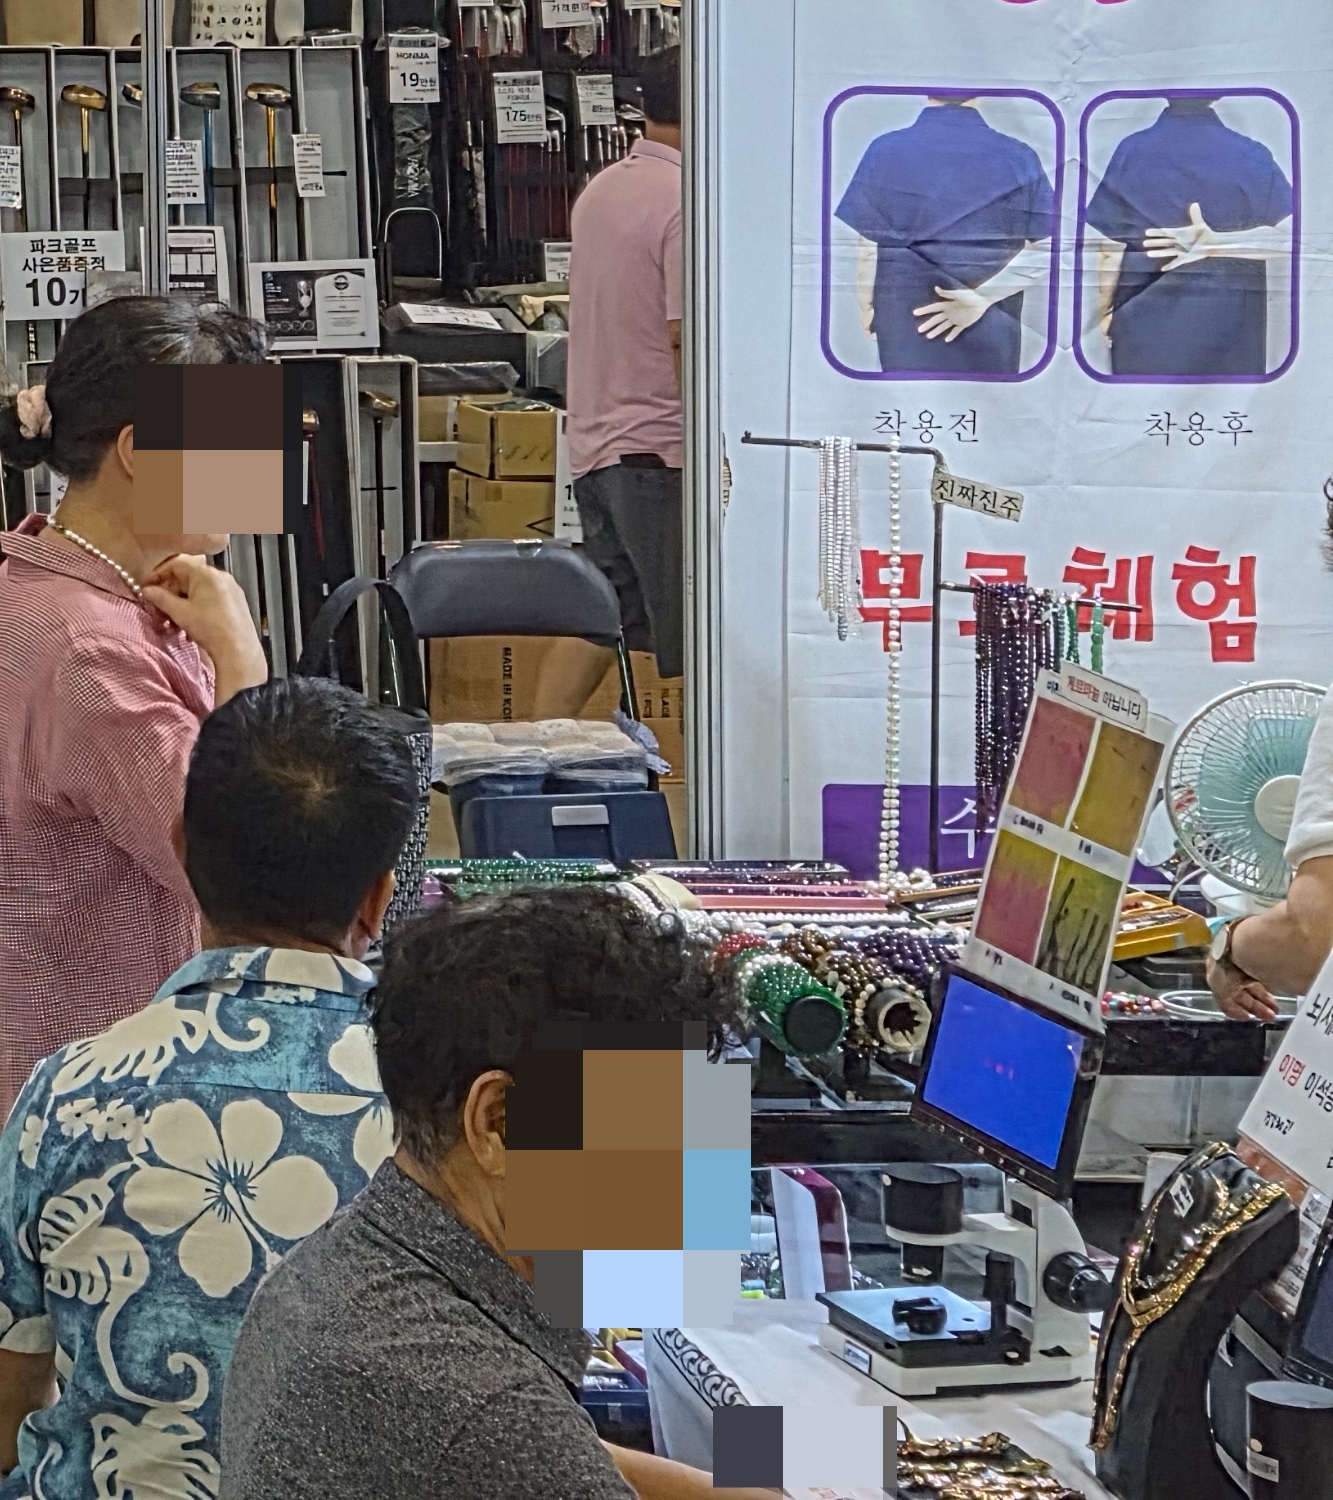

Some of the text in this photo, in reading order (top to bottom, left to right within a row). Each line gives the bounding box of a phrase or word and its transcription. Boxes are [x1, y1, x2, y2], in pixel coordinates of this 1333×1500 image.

[29, 236, 97, 253] 파크골프
[21, 255, 106, 273] 사은품증정
[873, 408, 981, 444] 착용전
[1143, 409, 1254, 448] 착용후
[934, 476, 1023, 519] 진짜진주
[1278, 1053, 1306, 1087] 이명
